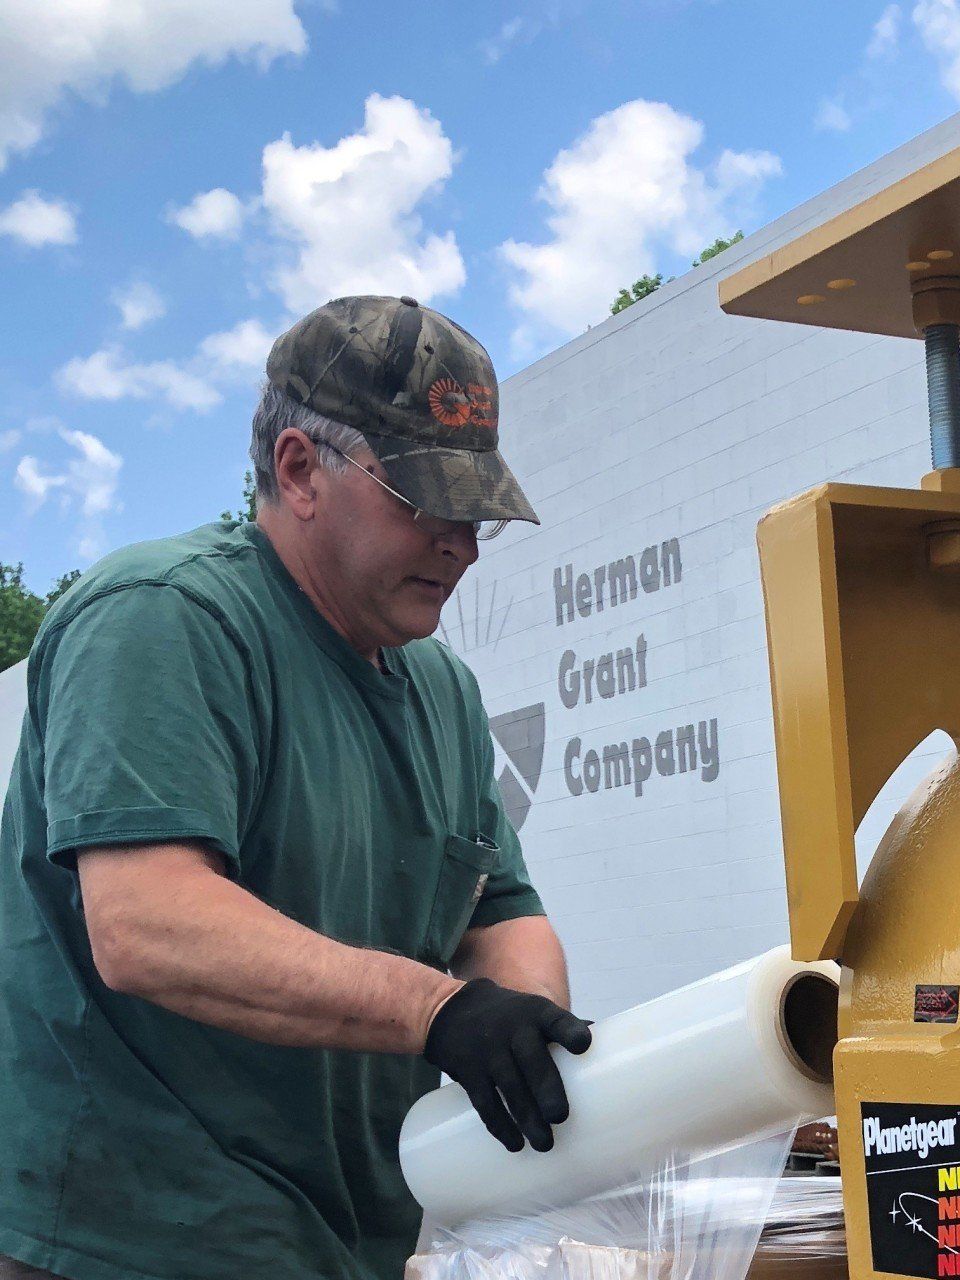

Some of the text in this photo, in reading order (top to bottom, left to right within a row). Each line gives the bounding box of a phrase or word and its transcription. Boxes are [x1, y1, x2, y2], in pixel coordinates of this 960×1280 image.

[553, 537, 682, 626] Herman
[558, 633, 647, 709] Grant
[564, 718, 719, 797] Company
[863, 1116, 956, 1158] Planetgear
